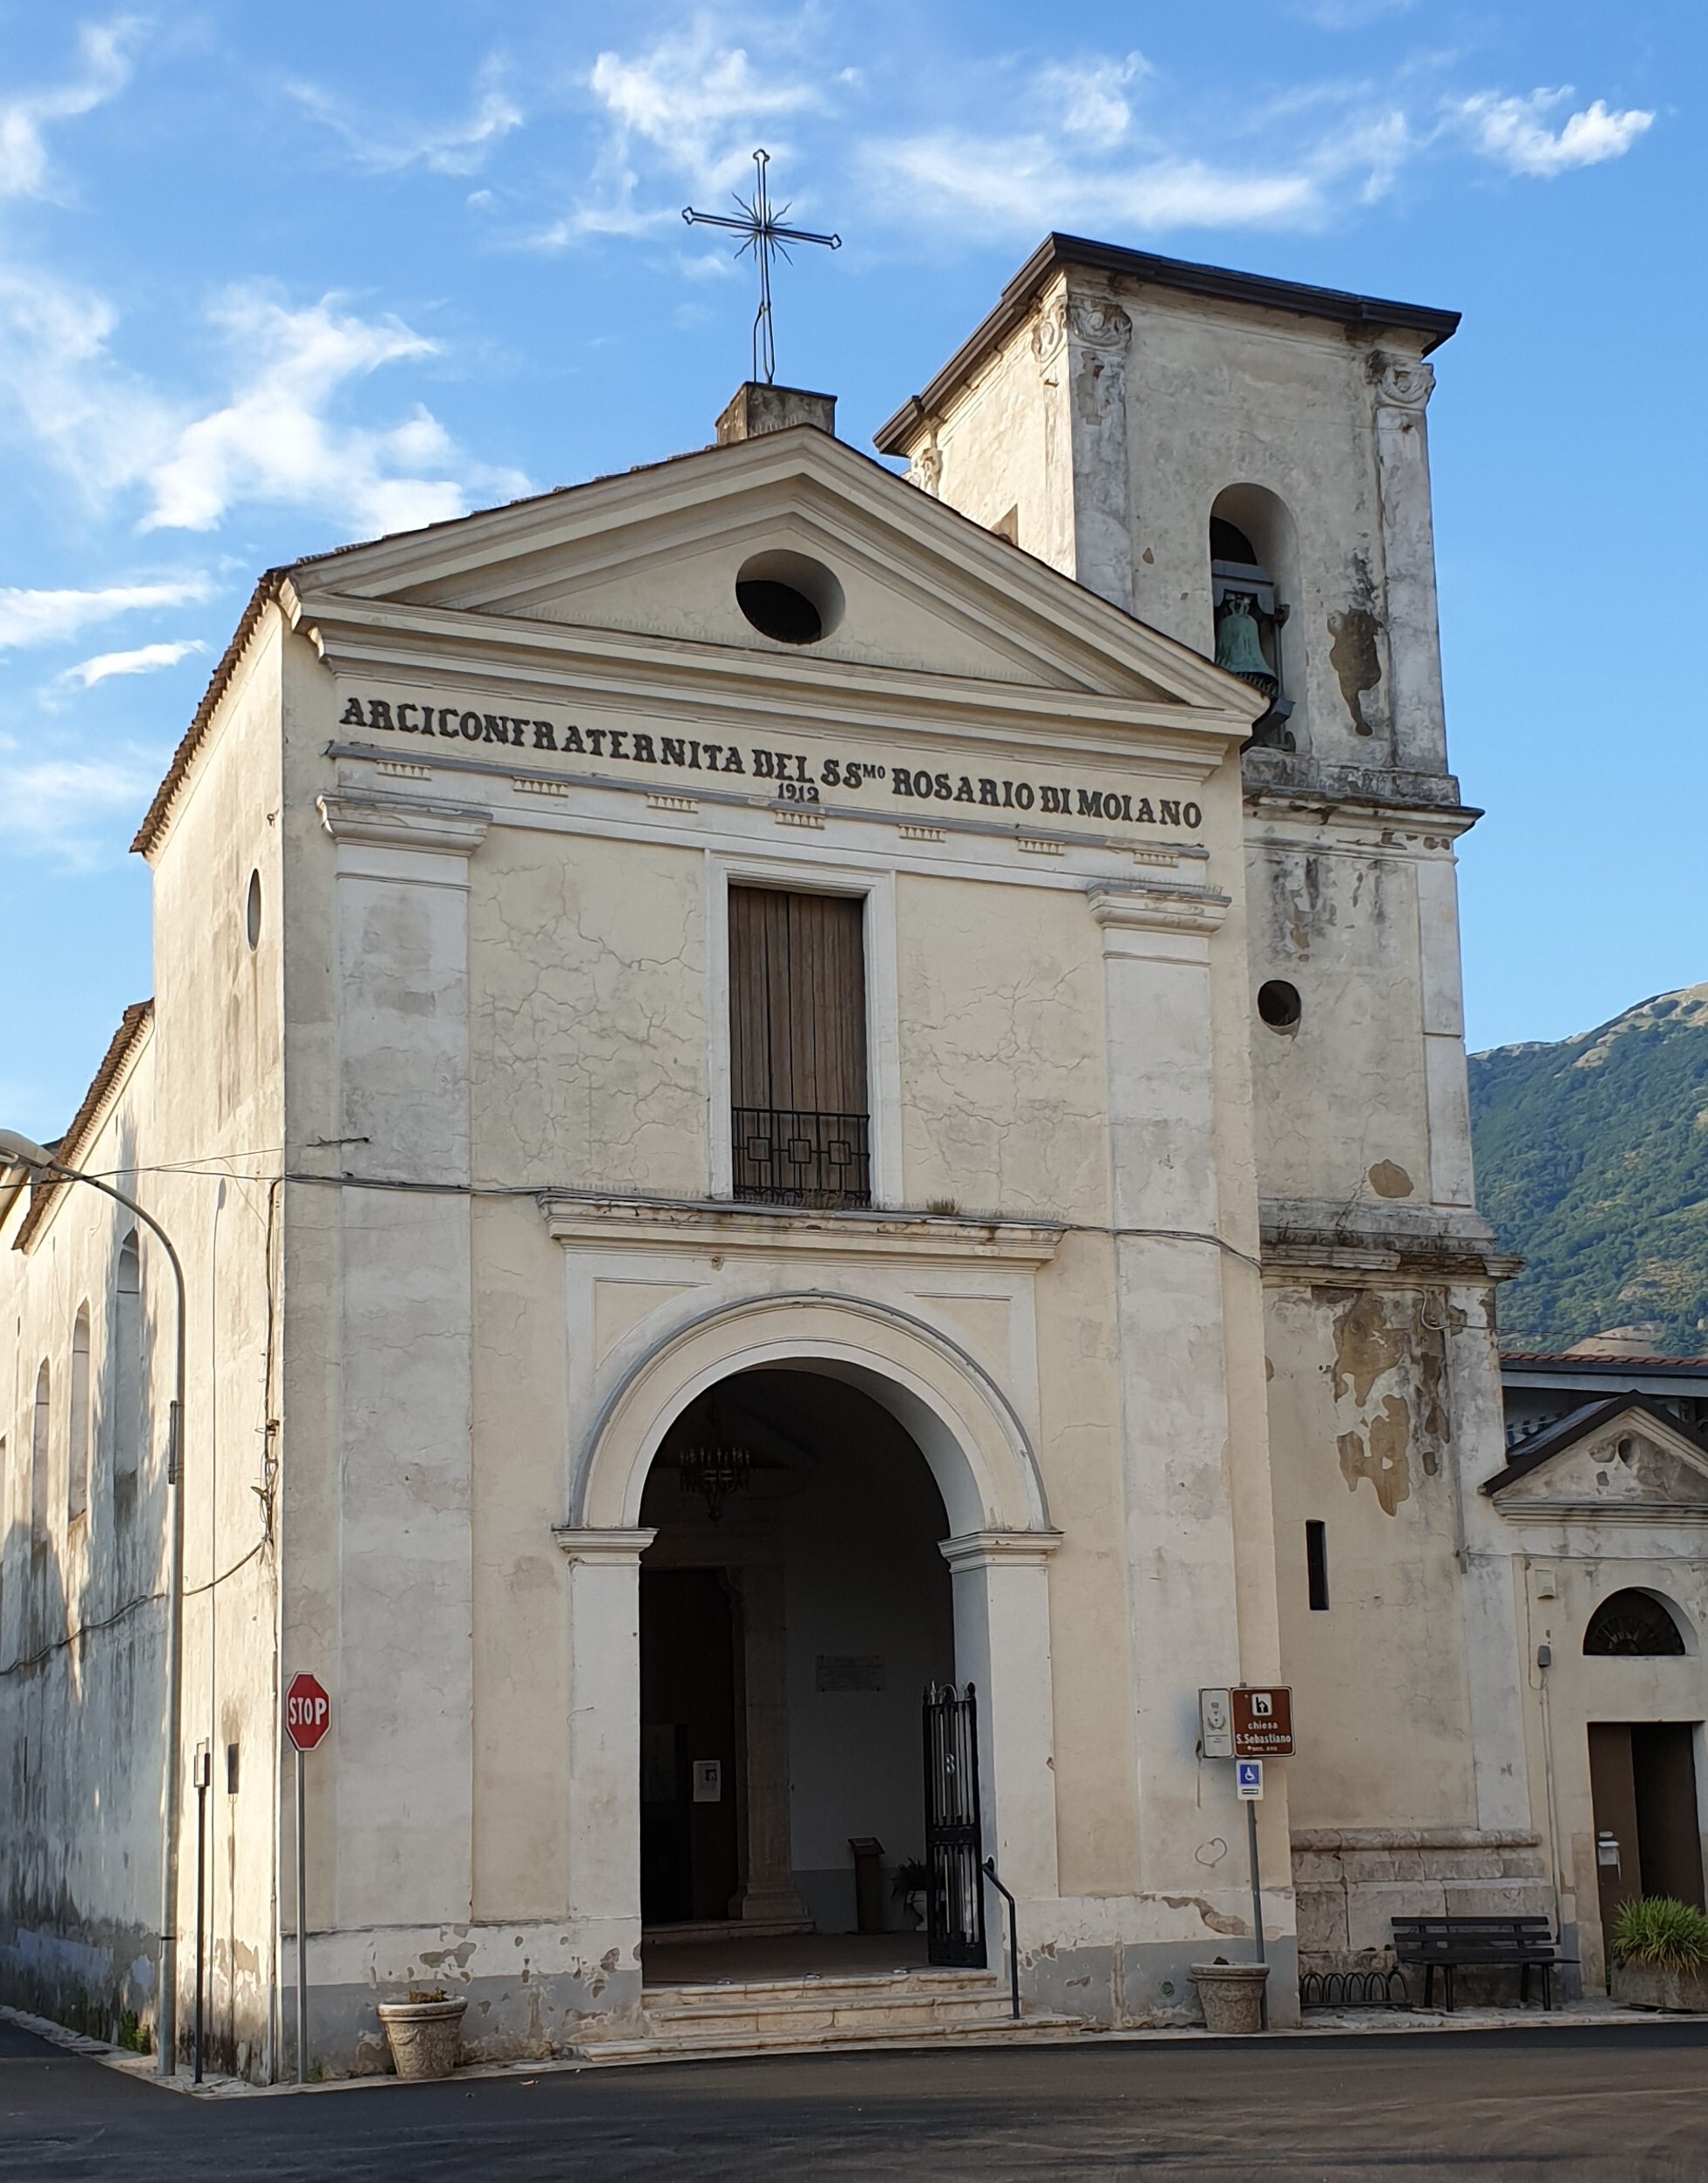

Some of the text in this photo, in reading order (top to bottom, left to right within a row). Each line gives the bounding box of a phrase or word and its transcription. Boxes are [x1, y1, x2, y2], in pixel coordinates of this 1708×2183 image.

[339, 698, 746, 774] ARCICONFRATERNITA
[751, 749, 815, 784] DEL
[891, 768, 1034, 810] ROSARIO
[1039, 786, 1073, 815] DI
[1077, 790, 1202, 829] MOIANO
[777, 783, 820, 804] 1912
[289, 1697, 327, 1725] STOP
[1247, 1720, 1278, 1730] chiesa
